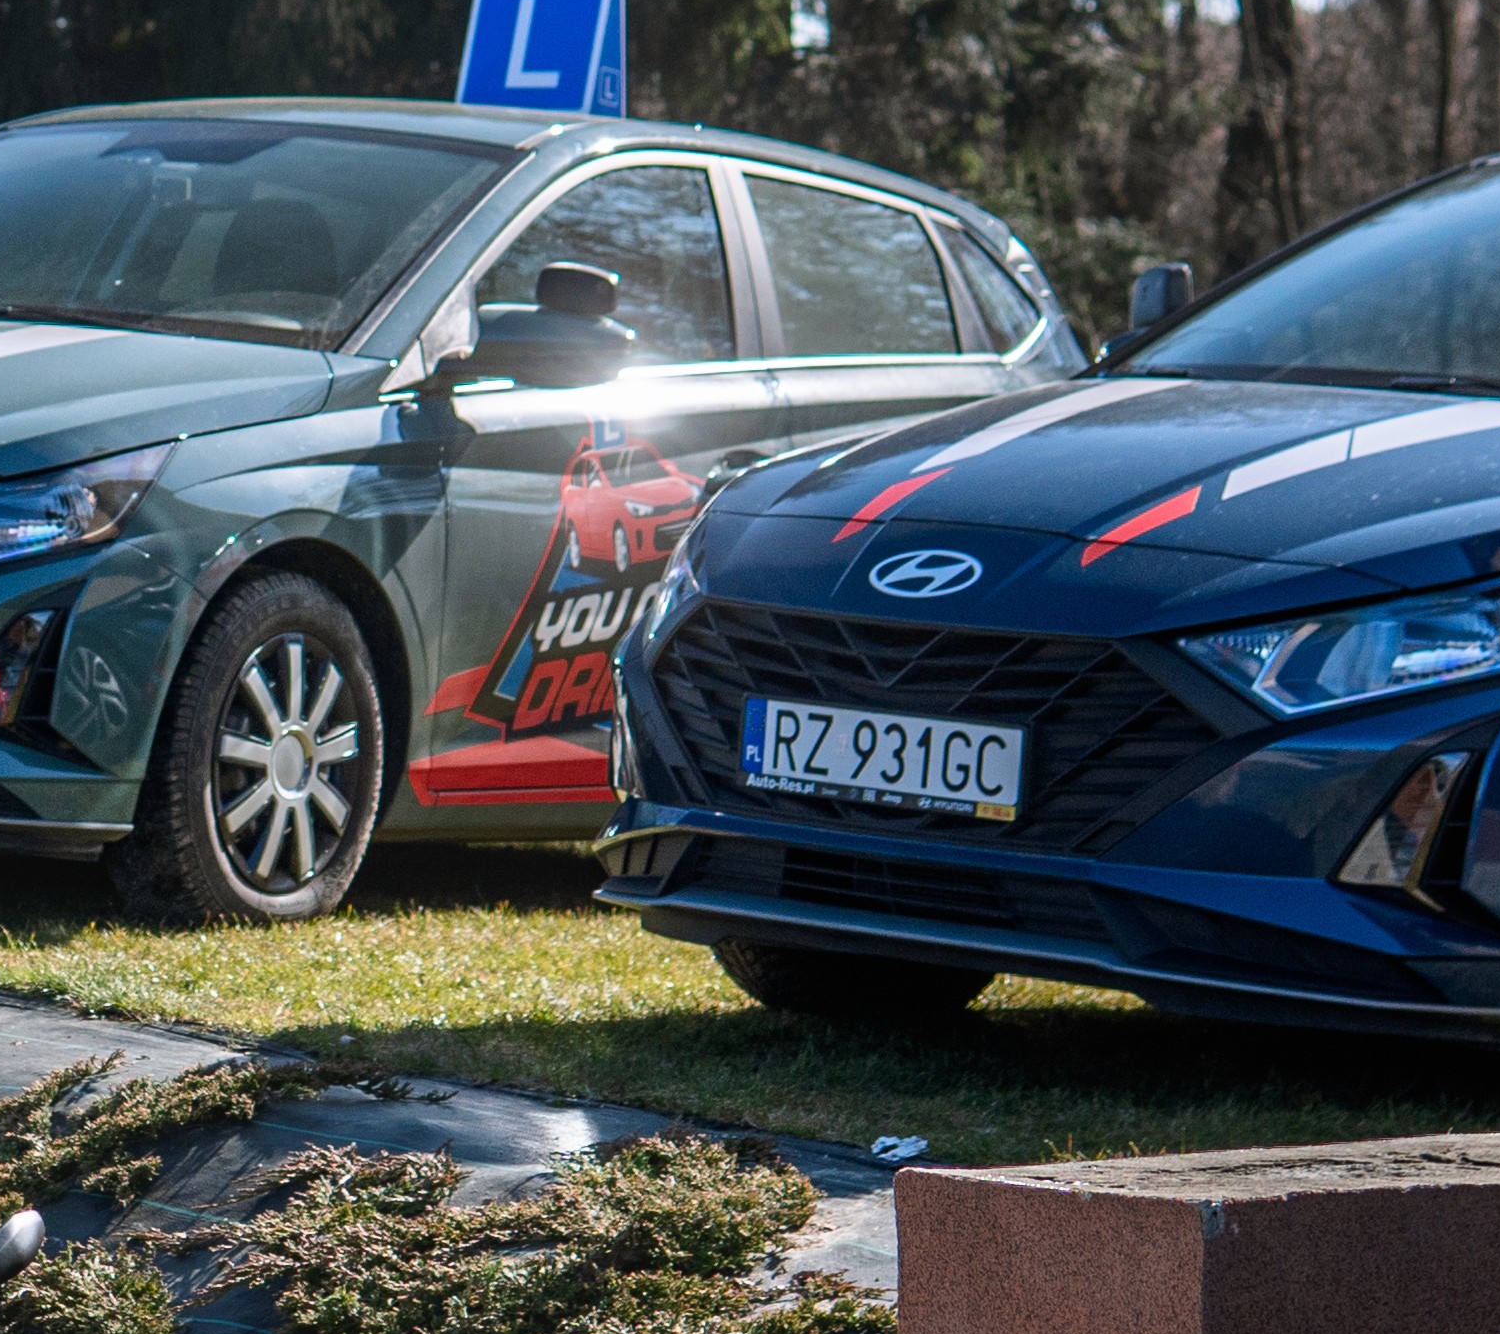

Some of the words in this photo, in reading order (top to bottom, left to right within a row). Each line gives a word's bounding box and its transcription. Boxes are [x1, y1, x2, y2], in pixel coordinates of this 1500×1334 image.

[535, 586, 634, 653] YOU
[512, 650, 616, 731] DRI
[745, 744, 762, 763] PL
[745, 772, 816, 794] Auto-Res.pl
[772, 709, 835, 776] RZ
[850, 719, 1007, 797] 931GC
